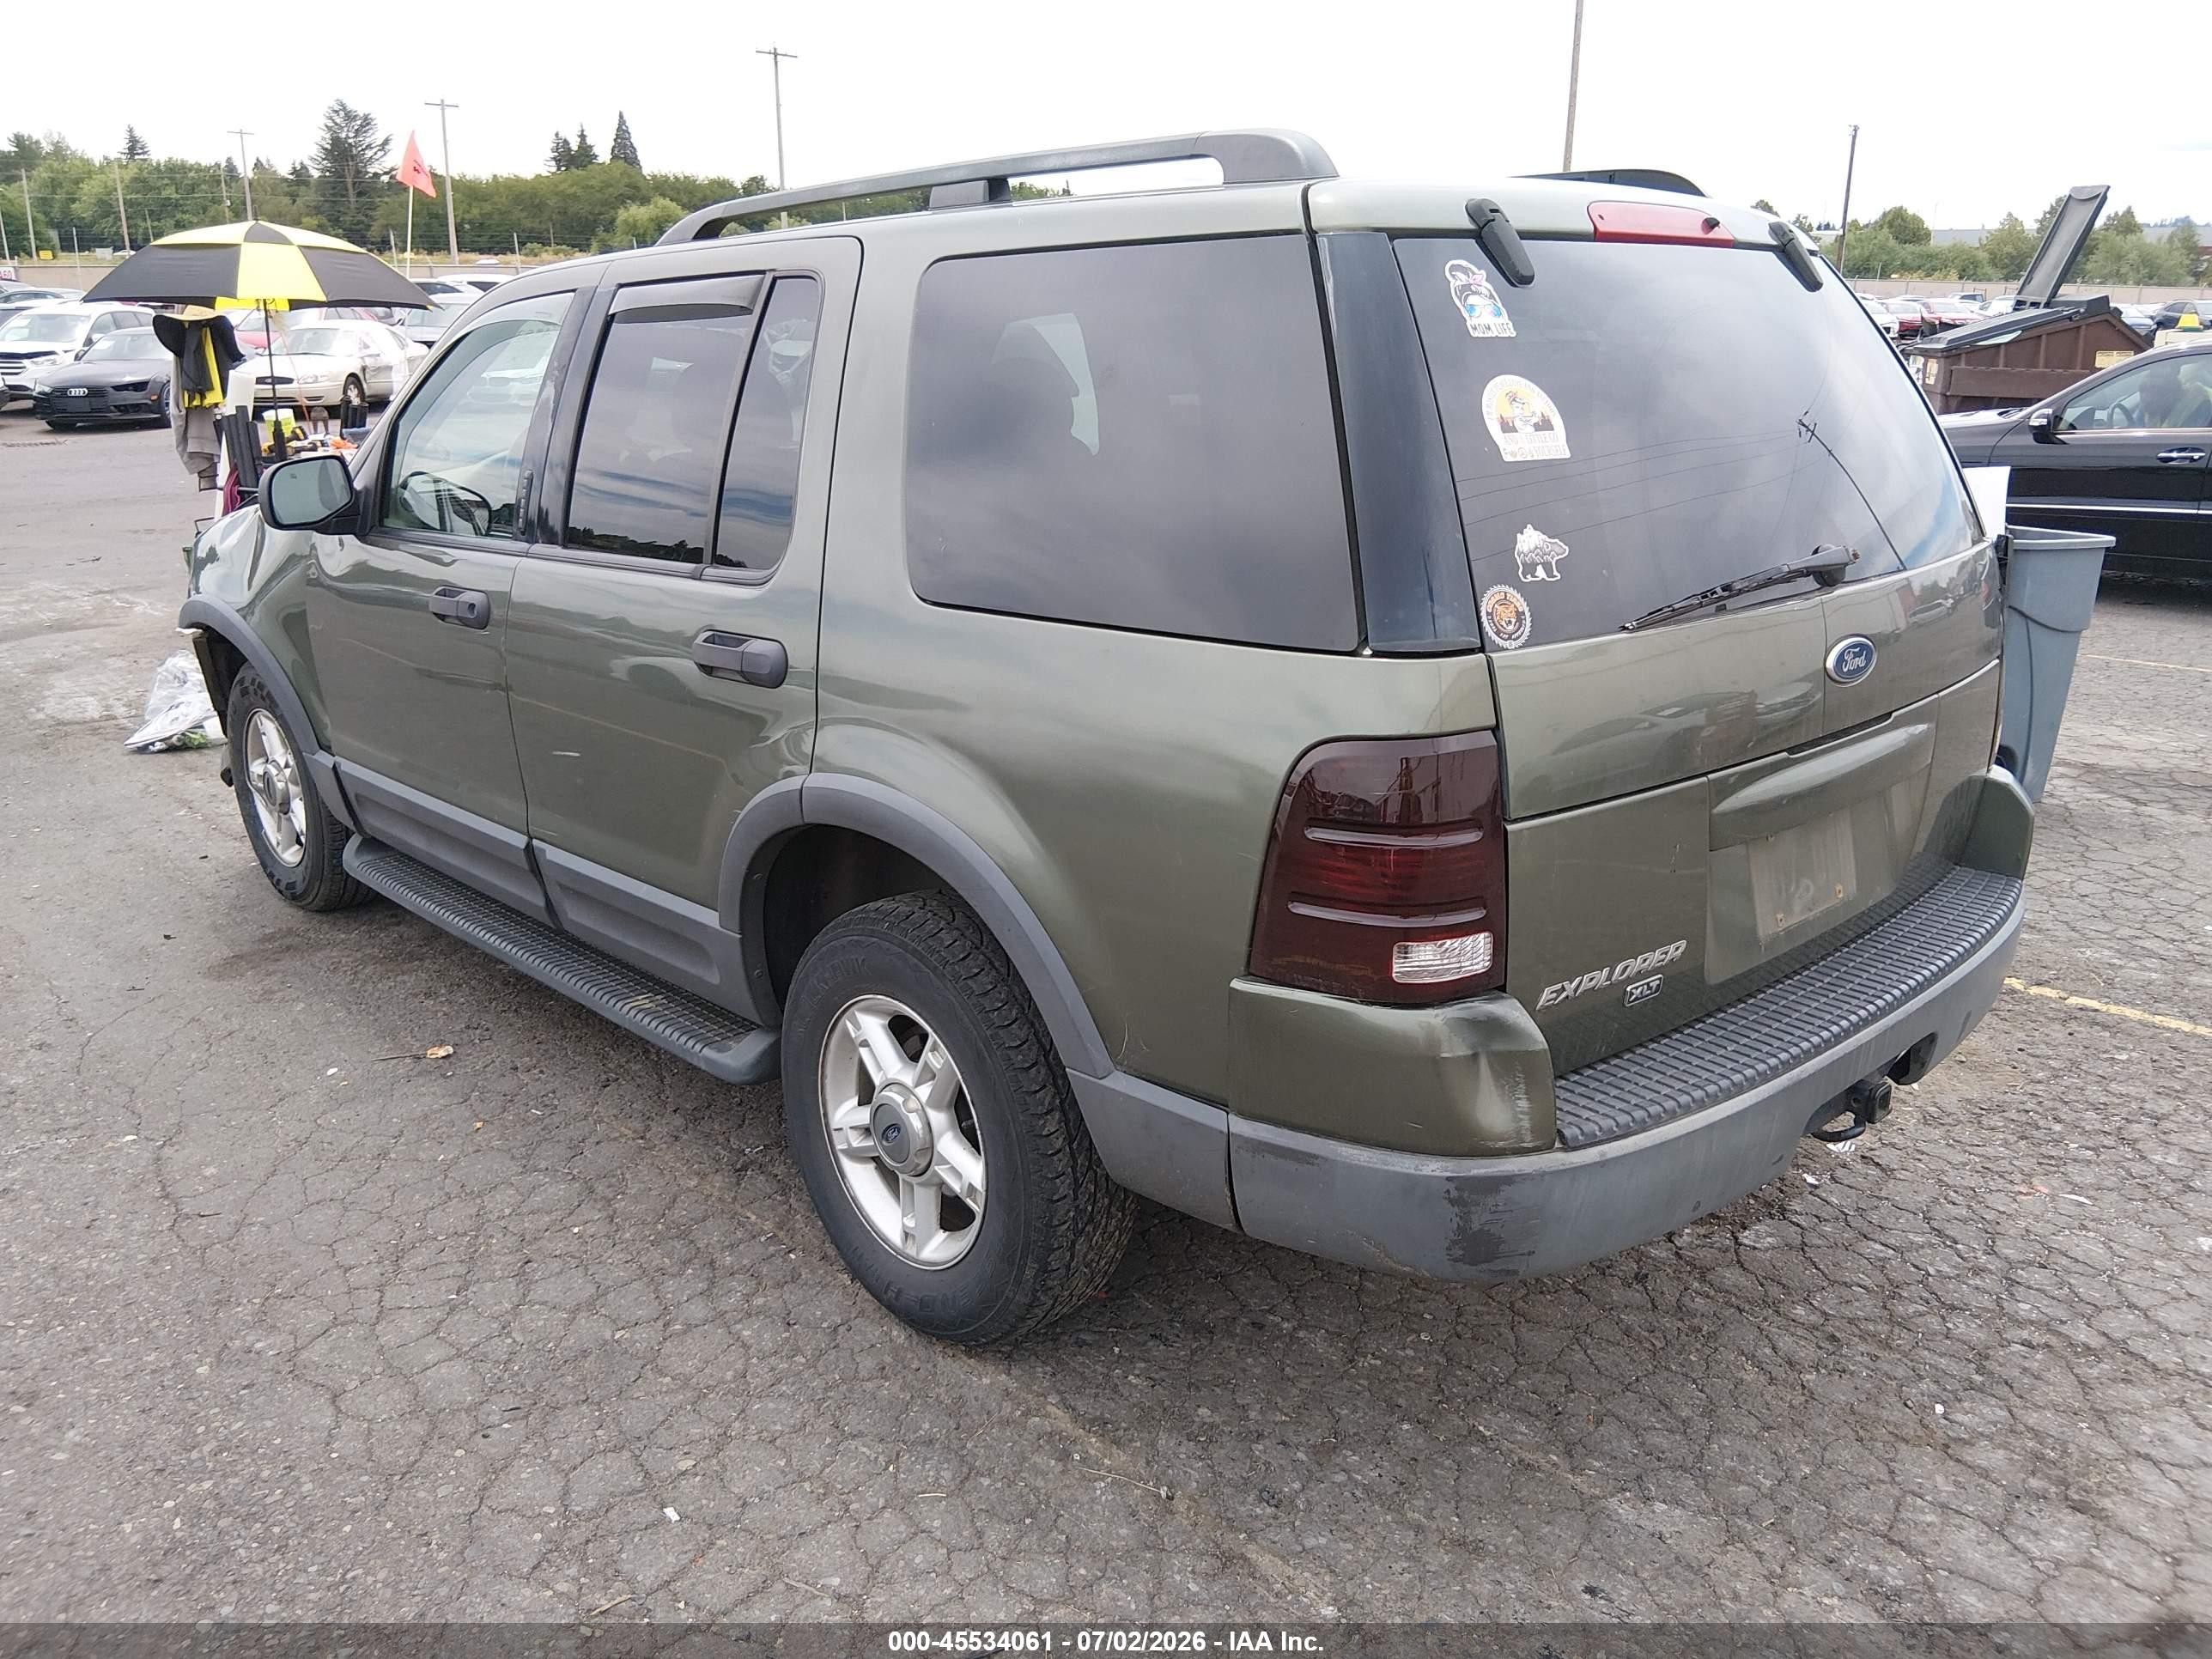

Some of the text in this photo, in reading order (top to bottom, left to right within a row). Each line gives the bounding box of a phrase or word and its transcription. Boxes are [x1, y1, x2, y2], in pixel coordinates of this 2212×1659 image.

[1470, 323, 1515, 335] MOM LIFE
[1842, 647, 1866, 672] Ford
[1535, 939, 1686, 1011] EXPLORER
[1629, 980, 1660, 1001] XLT
